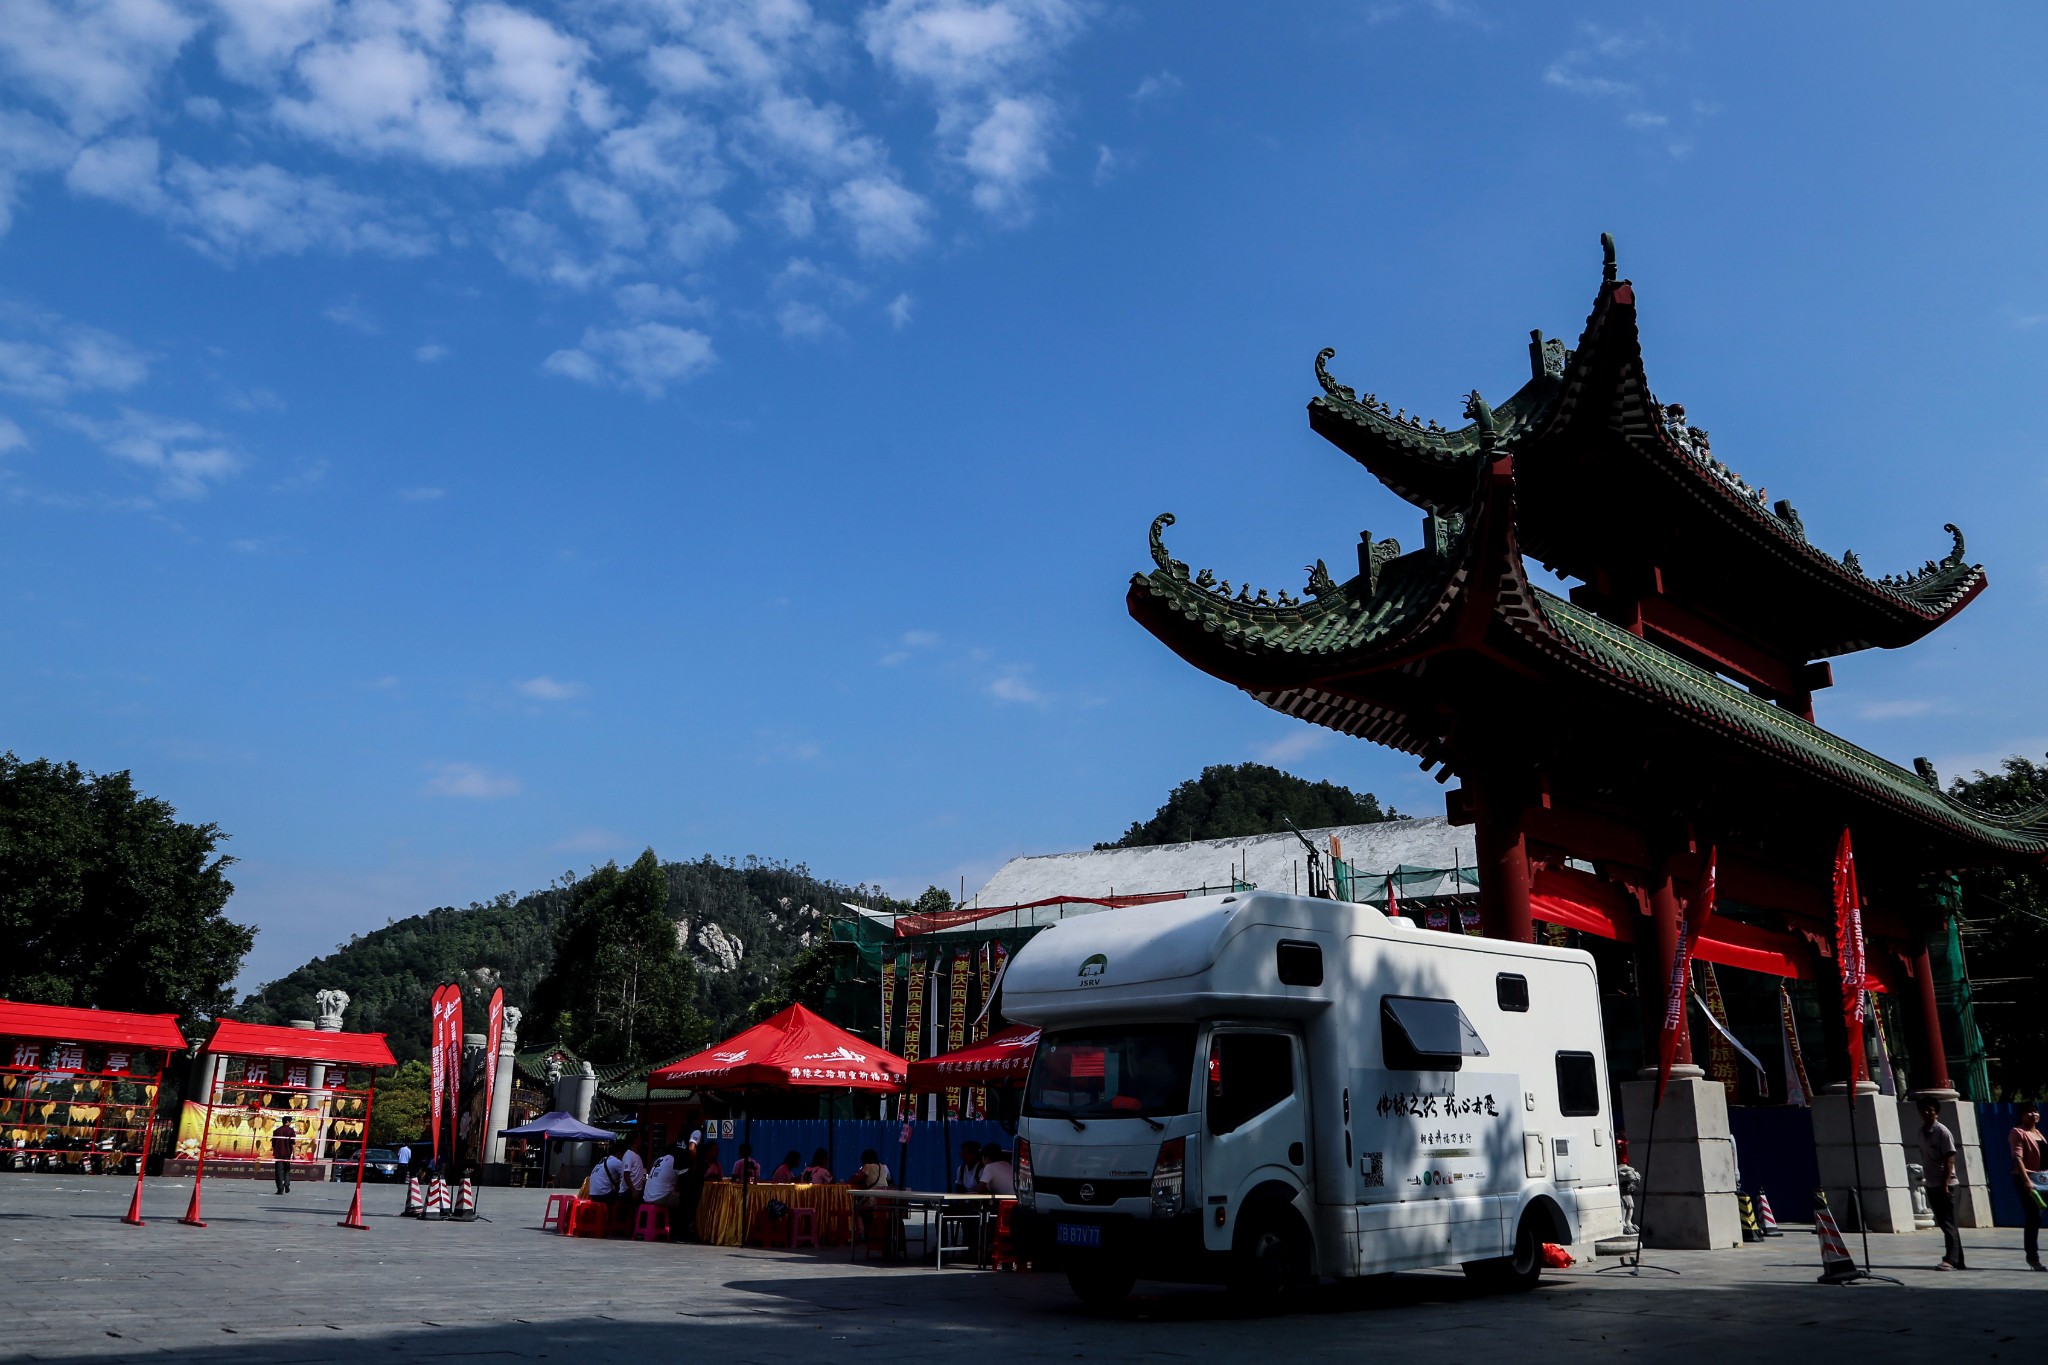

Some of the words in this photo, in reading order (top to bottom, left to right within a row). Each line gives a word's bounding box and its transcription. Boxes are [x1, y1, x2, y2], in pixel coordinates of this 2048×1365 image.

[1080, 979, 1100, 987] JSRV
[14, 1044, 131, 1071] 祈福亭
[247, 1063, 346, 1088] 祈福亭
